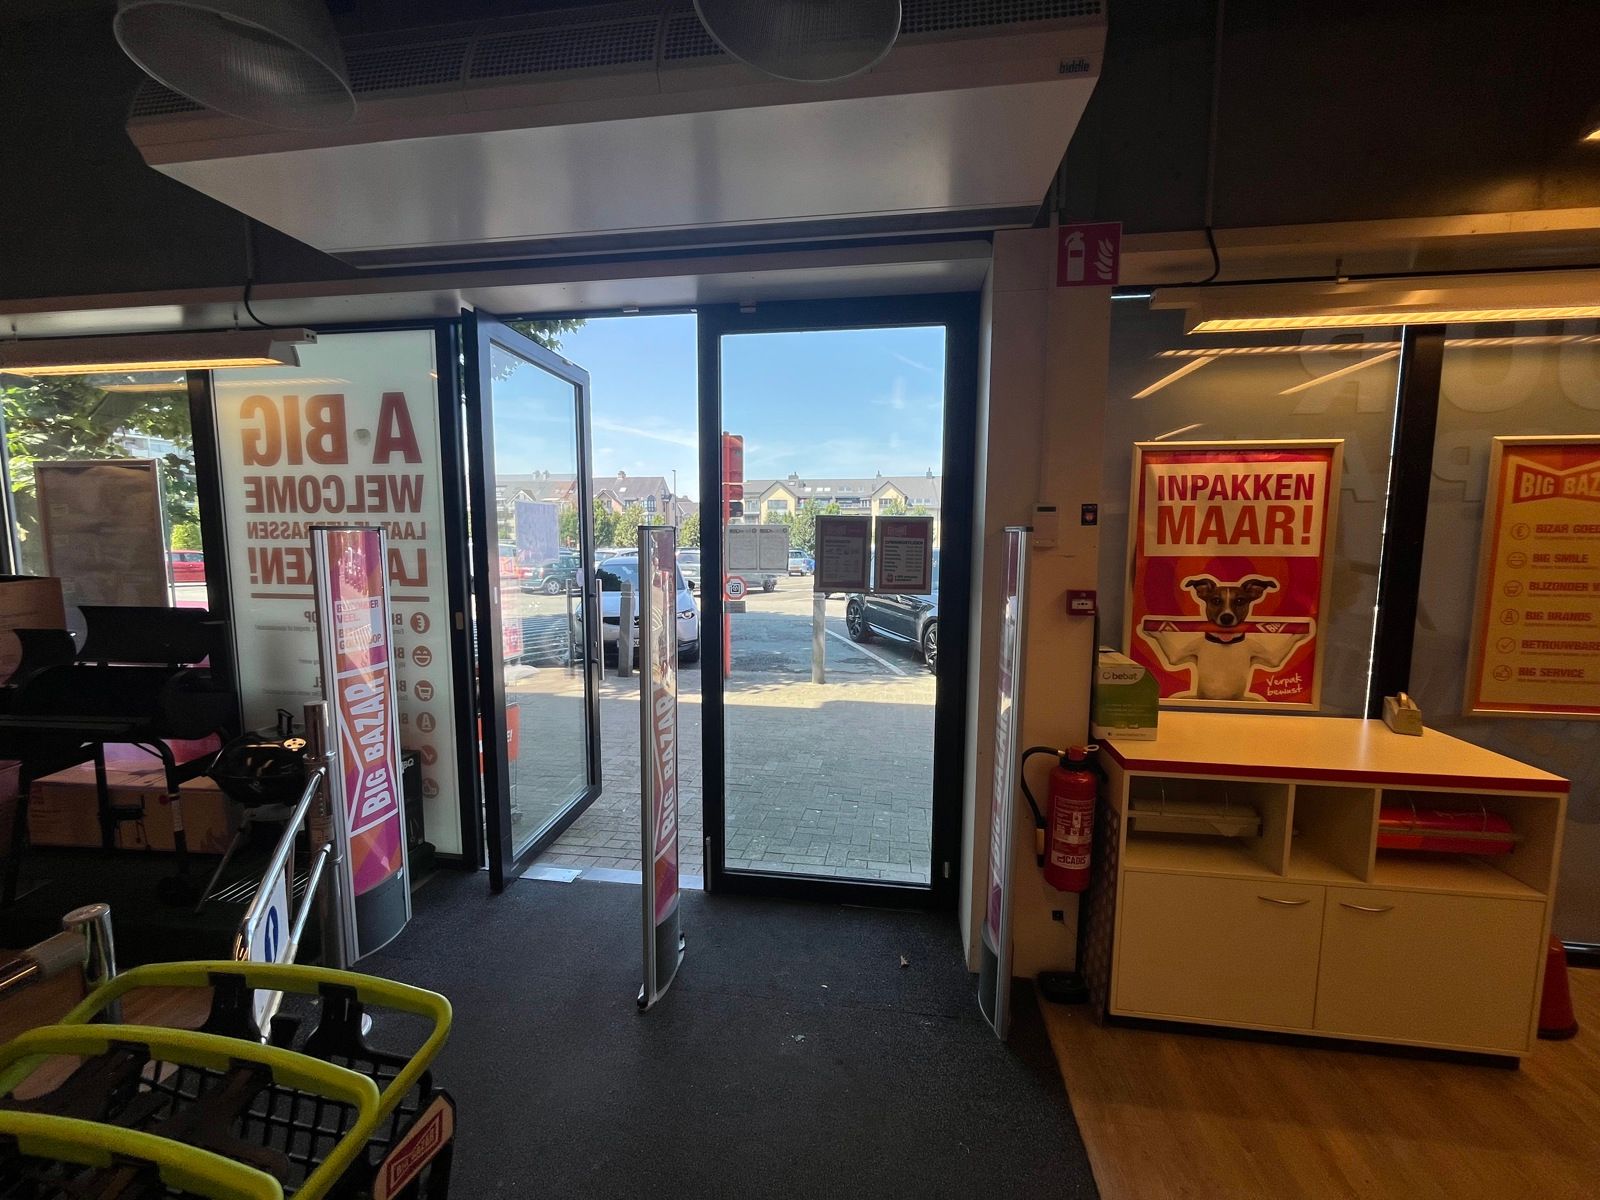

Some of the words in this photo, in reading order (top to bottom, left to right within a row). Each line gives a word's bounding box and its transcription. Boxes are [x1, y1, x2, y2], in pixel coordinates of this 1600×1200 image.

[1157, 473, 1315, 501] INPAKKEN
[1519, 471, 1555, 498] BIG
[1156, 504, 1314, 545] MAAR!
[1111, 671, 1138, 681] bebat
[1266, 673, 1303, 688] Verpak
[1539, 667, 1585, 678] SERVICE
[344, 675, 385, 763] BAZAR
[361, 767, 392, 818] BIG
[660, 790, 675, 842] BIG
